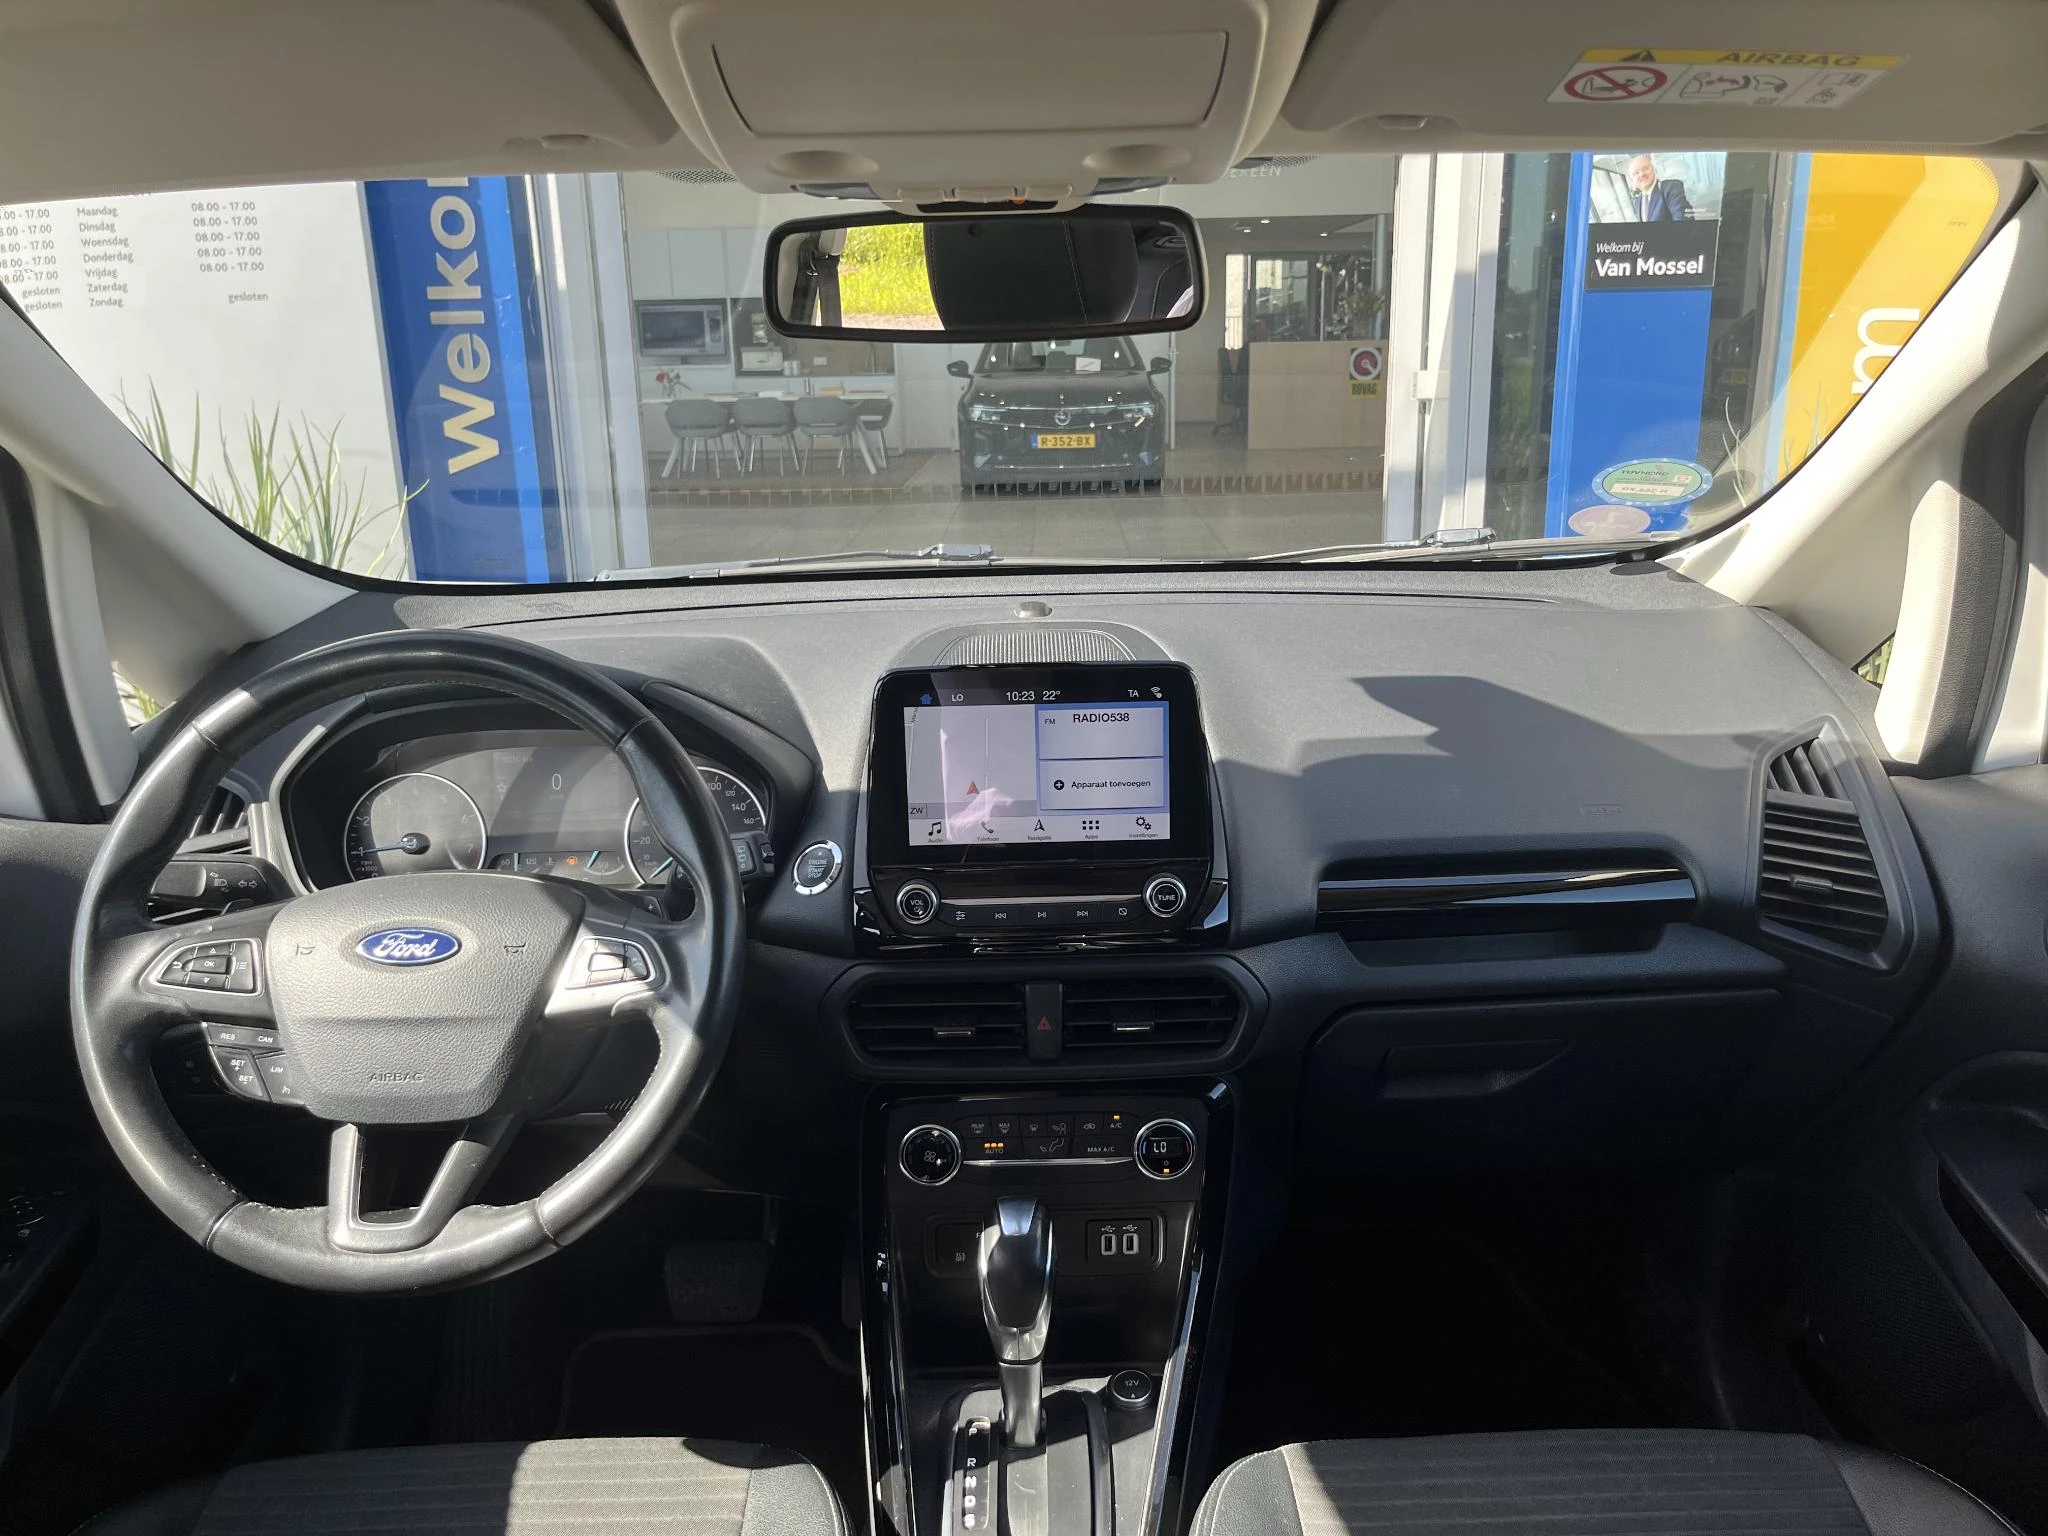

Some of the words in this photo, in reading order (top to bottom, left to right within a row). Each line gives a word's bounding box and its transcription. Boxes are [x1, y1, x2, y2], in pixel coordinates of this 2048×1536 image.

[1715, 52, 1862, 67] AIRBAG
[1229, 165, 1282, 178] EREEN
[0, 210, 15, 220] .00
[25, 209, 50, 219] 17.00
[77, 206, 118, 219] Maandag
[191, 203, 219, 212] 08.00
[230, 202, 256, 212] 17.00
[0, 225, 18, 237] 8.00
[28, 224, 52, 235] 17.00
[79, 221, 116, 234] Dinsdag
[193, 217, 222, 227] 08.00
[231, 216, 258, 227] 17.00
[81, 236, 130, 249] Woensdag
[195, 233, 224, 242] 08.00
[234, 231, 260, 242] 17.00
[0, 242, 20, 253] 8.00
[30, 240, 54, 250] 17.00
[1596, 242, 1631, 253] Welkom
[1631, 241, 1645, 255] bij
[32, 256, 56, 266] 17.00
[83, 252, 134, 264] Donderdag
[197, 248, 226, 258] 08.00
[236, 247, 262, 257] 17.00
[85, 267, 118, 280] Vrijdag
[199, 263, 228, 273] 08.00
[238, 262, 265, 272] 17.00
[1595, 258, 1631, 277] Van
[1636, 255, 1704, 276] Mossel
[34, 271, 59, 281] 17.00
[22, 286, 61, 299] gesloten
[87, 282, 129, 294] Zaterdag
[89, 297, 124, 308] Zondag
[228, 292, 269, 304] gesloten
[24, 301, 63, 314] gesloten
[1040, 434, 1091, 447] R-352-BX
[951, 693, 964, 702] LO
[1005, 691, 1036, 702] 10:23
[1042, 690, 1062, 701] 22°
[1128, 689, 1140, 698] TA
[1072, 712, 1131, 723] RADIO538
[551, 773, 562, 790] 0
[1071, 780, 1108, 789] Apparaat
[1109, 778, 1151, 789] toevoegen
[731, 802, 746, 811] 140
[910, 807, 924, 815] ZW
[363, 816, 370, 826] 2
[461, 814, 468, 824] 6
[743, 817, 755, 825] 160
[640, 836, 650, 845] 20
[468, 844, 474, 853] 7
[808, 858, 828, 867] ENGINE
[807, 867, 825, 875] START
[910, 899, 924, 907] VOL
[1158, 894, 1176, 902] TUNE
[373, 932, 438, 958] Ford
[220, 1032, 236, 1041] RES
[258, 1035, 273, 1043] CAN
[230, 1059, 246, 1067] SET
[239, 1075, 253, 1083] SET
[368, 1072, 424, 1083] AIRBAG
[1101, 1145, 1116, 1153] A/C
[1153, 1141, 1168, 1153] LO
[1124, 1378, 1139, 1387] 12V
[967, 1458, 977, 1468] R
[965, 1476, 977, 1488] N
[964, 1495, 976, 1509] D
[964, 1515, 976, 1529] S
